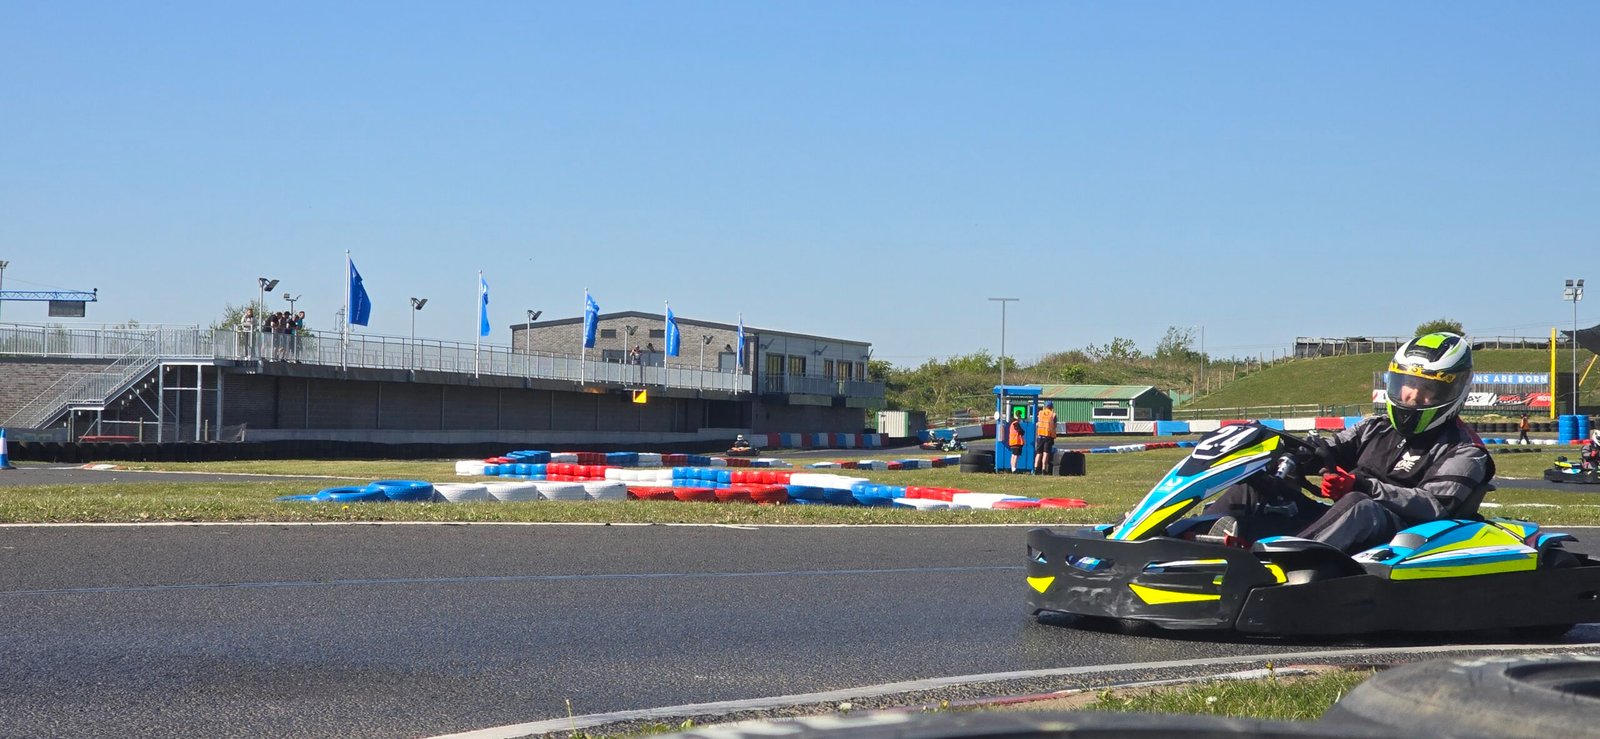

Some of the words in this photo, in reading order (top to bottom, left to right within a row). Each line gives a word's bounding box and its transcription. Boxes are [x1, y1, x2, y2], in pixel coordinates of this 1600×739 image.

[1493, 375, 1514, 383] ARE
[1518, 375, 1548, 383] BORN
[1199, 425, 1258, 453] 24
